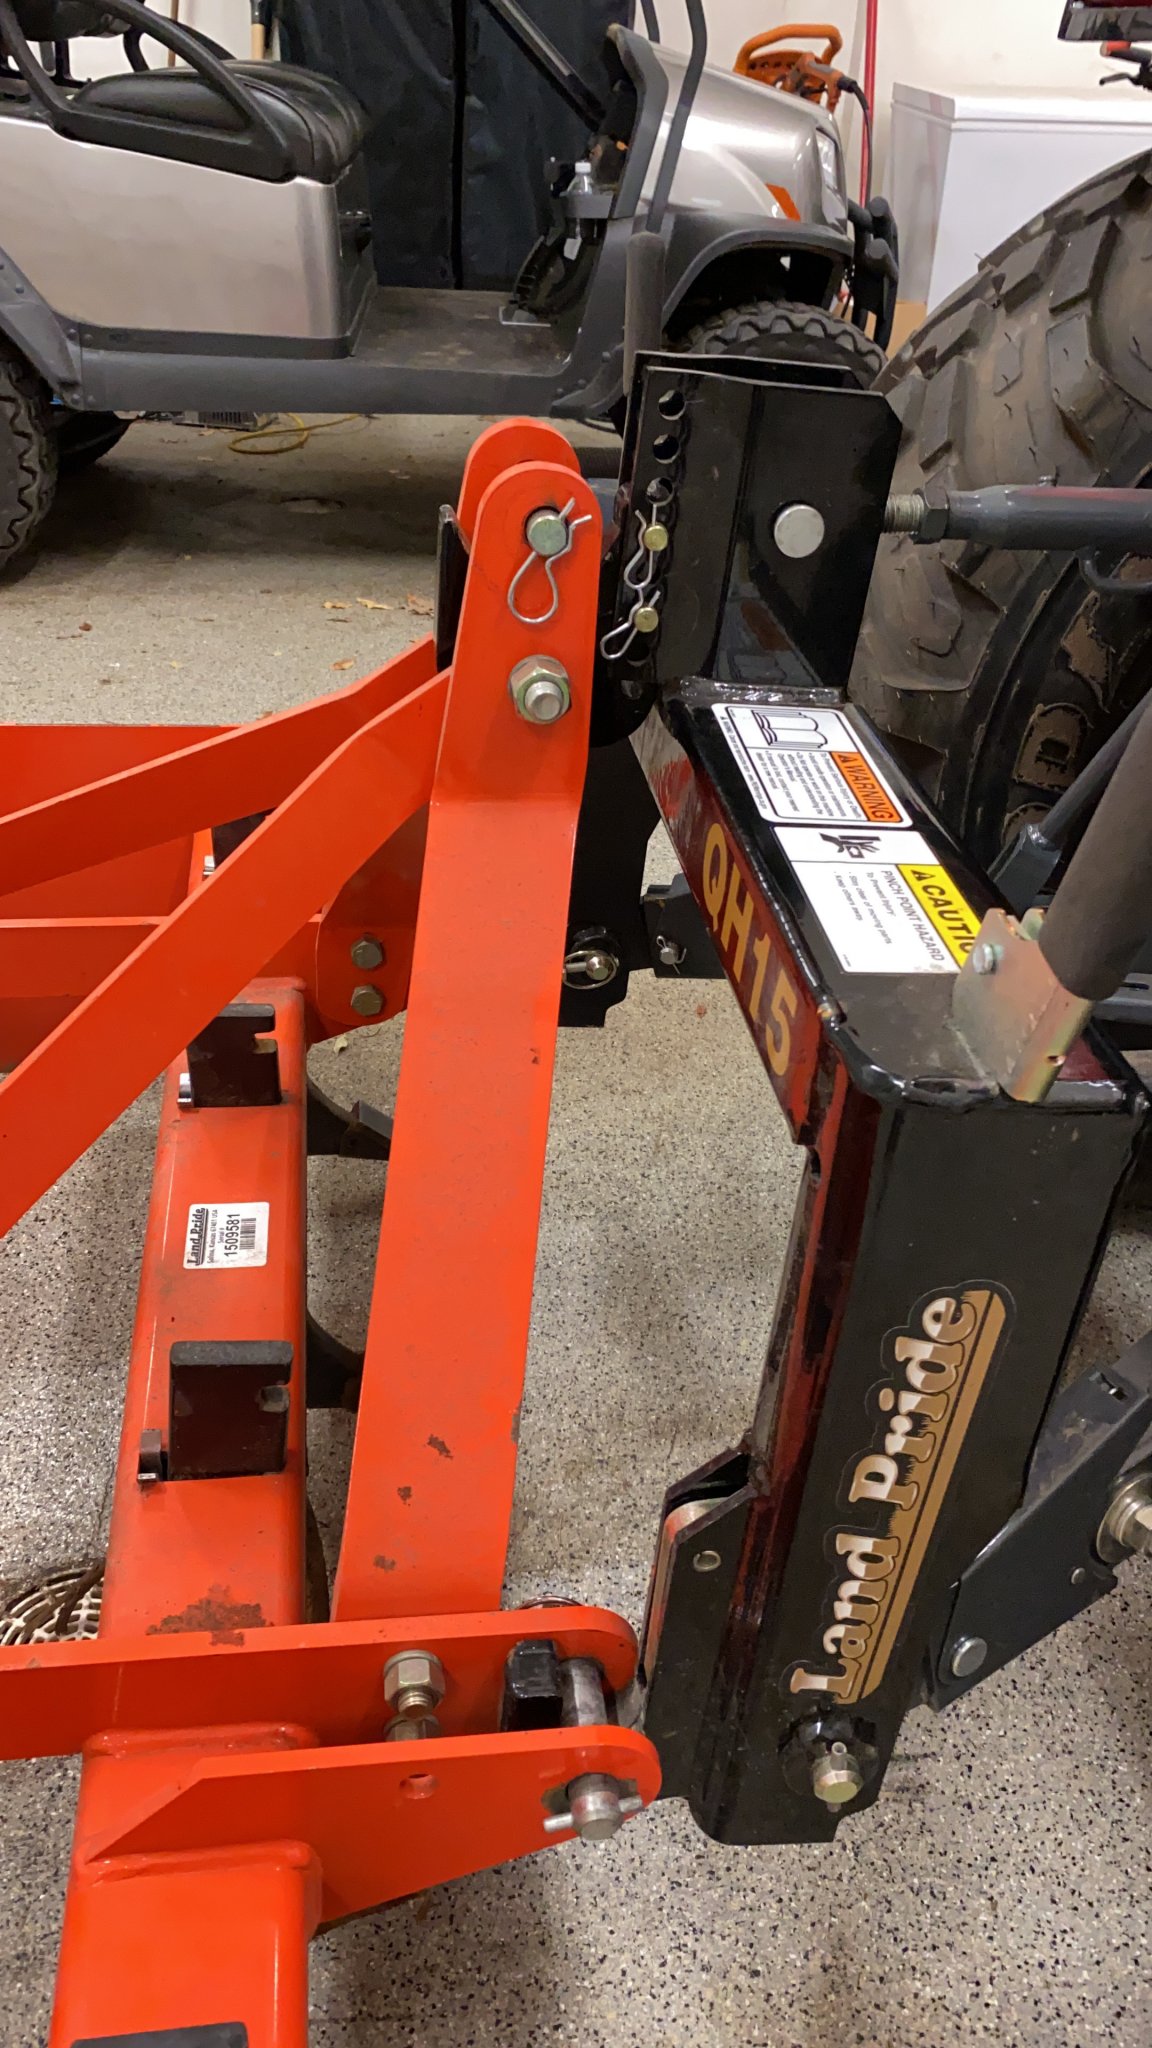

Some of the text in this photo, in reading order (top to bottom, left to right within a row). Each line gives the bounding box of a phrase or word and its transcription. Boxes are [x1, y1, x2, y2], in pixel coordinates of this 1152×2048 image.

[843, 764, 894, 818] WARNING
[832, 875, 848, 887] Keep
[841, 888, 857, 905] others
[848, 875, 861, 886] Stay
[854, 887, 868, 899] clear
[869, 879, 887, 898] Prevent
[864, 908, 884, 928] moving
[880, 870, 946, 961] PINCH POINT HAZARD
[703, 823, 797, 1076] QH15
[187, 1207, 205, 1265] Land Pride
[224, 1213, 241, 1257] 1509581
[789, 1296, 978, 1701] Land Pride
